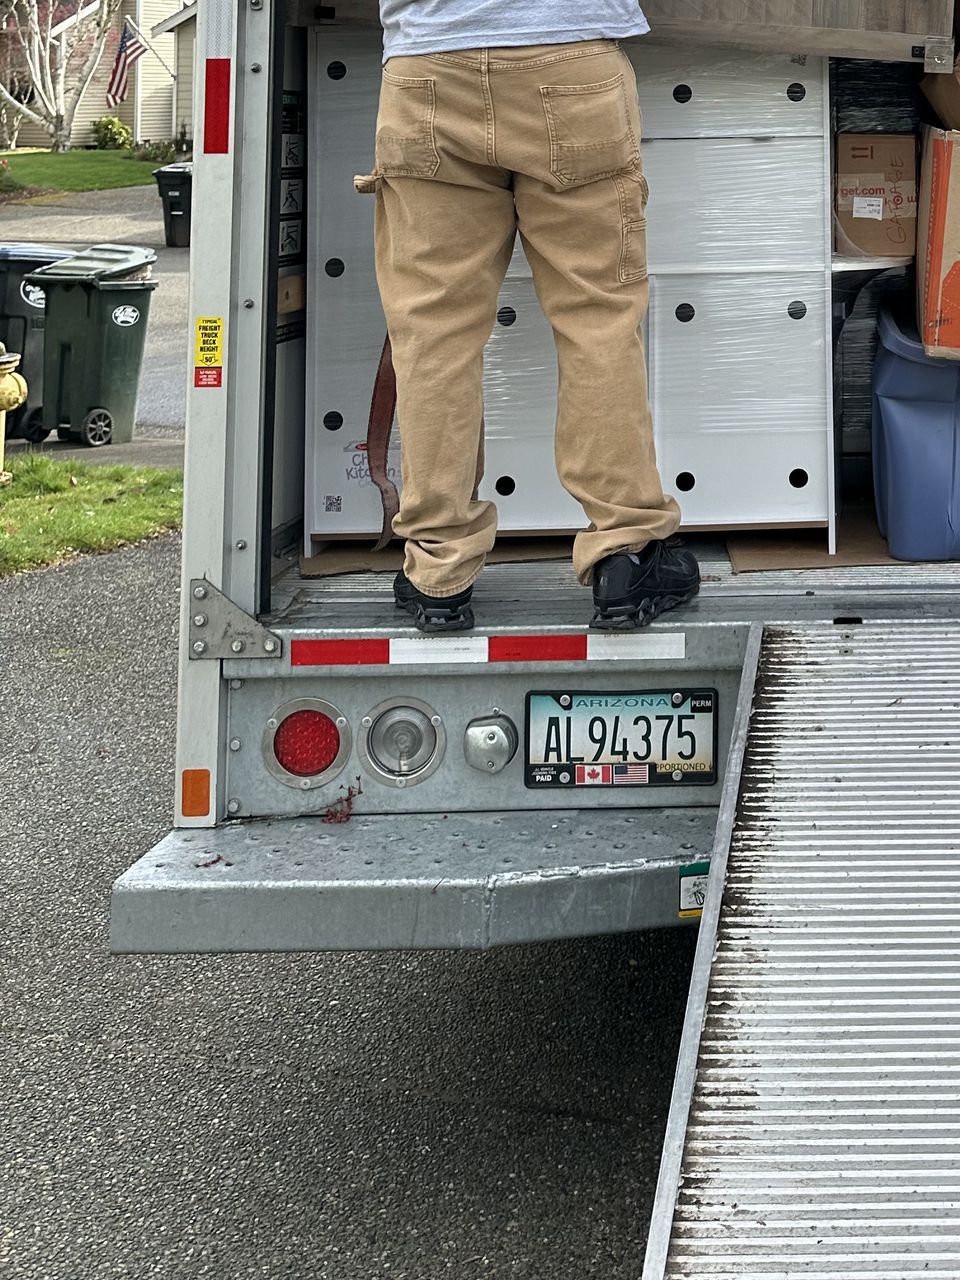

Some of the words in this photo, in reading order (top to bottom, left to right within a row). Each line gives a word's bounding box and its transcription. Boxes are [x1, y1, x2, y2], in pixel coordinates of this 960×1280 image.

[575, 698, 670, 708] ARIZONA
[692, 700, 712, 708] PERM
[543, 714, 696, 763] AL94375
